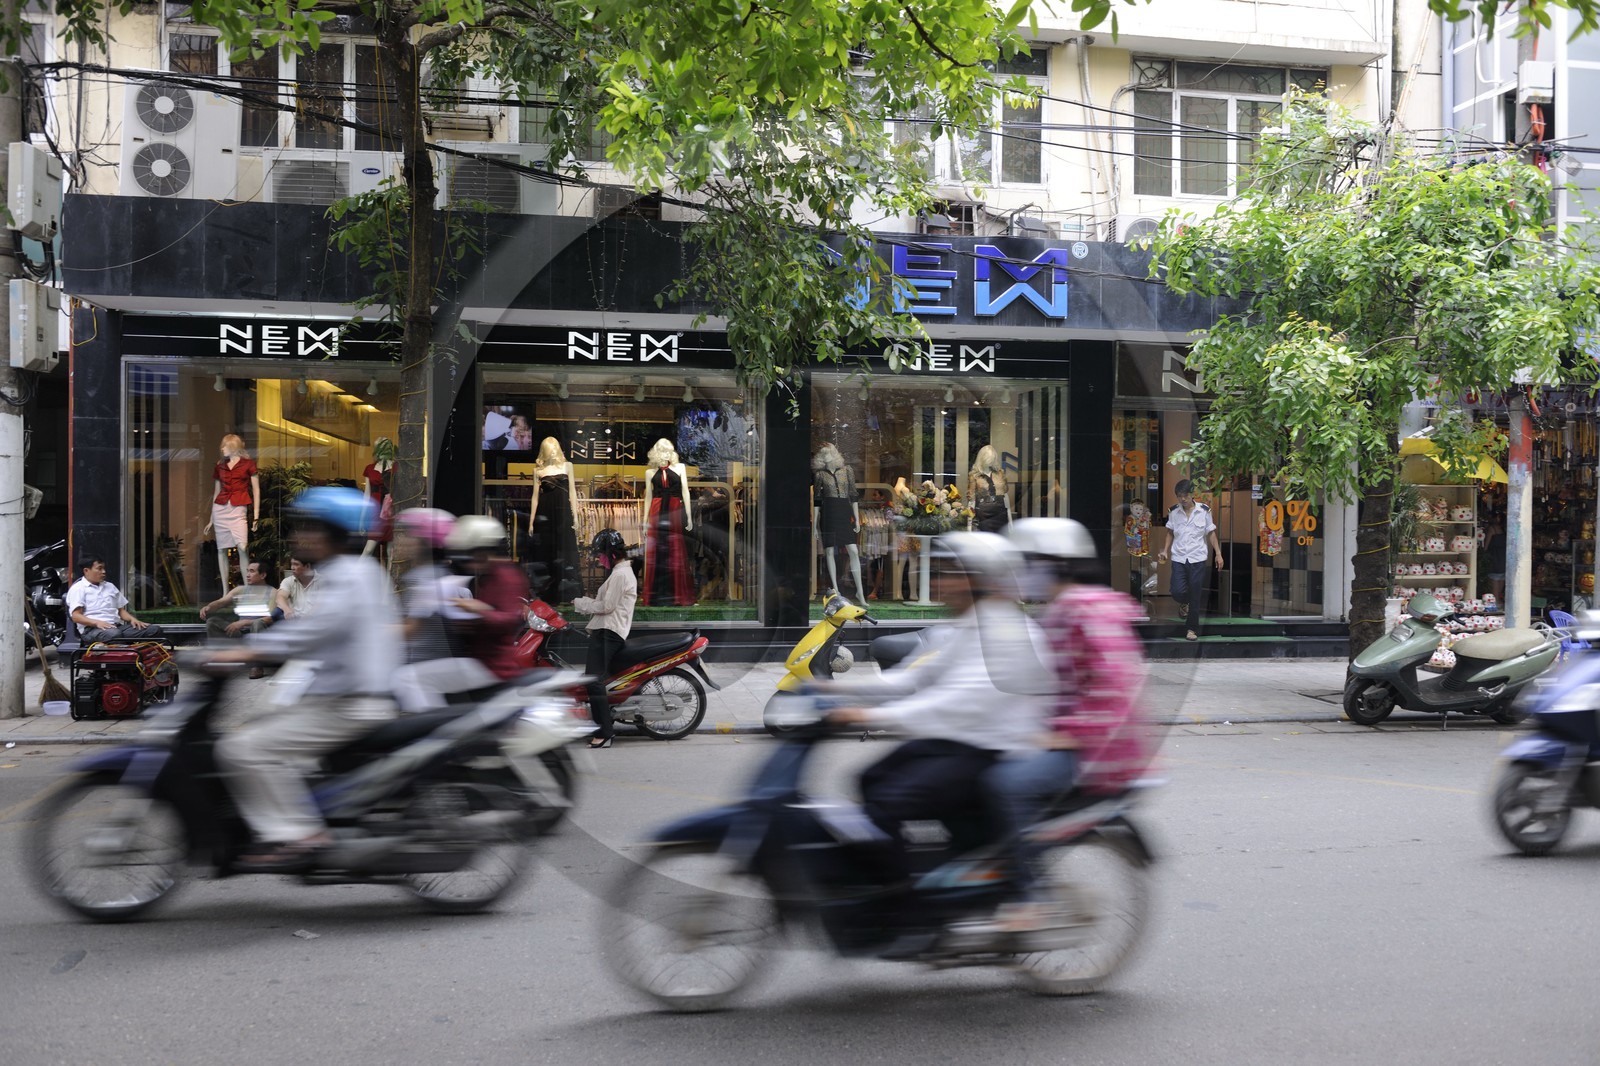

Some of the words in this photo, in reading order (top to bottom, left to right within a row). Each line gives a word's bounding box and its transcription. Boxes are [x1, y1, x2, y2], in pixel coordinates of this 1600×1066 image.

[220, 324, 338, 356] NEM
[568, 332, 678, 362] NEM
[893, 343, 994, 372] NEM
[571, 440, 635, 459] NEM
[1266, 500, 1317, 531] 0%
[1297, 535, 1314, 546] Off
